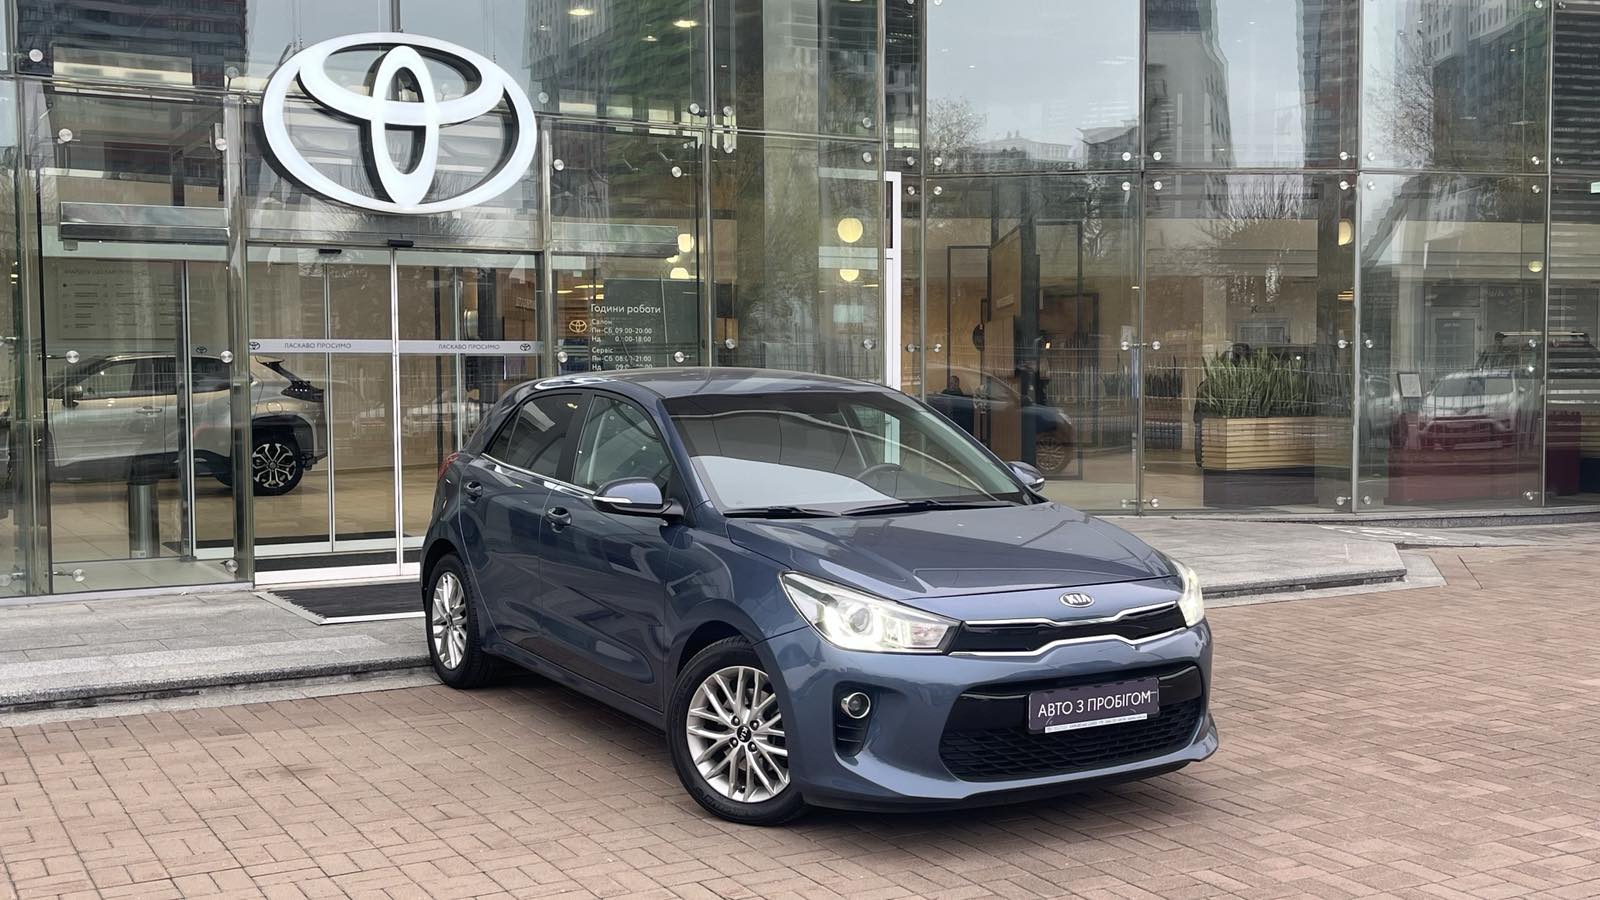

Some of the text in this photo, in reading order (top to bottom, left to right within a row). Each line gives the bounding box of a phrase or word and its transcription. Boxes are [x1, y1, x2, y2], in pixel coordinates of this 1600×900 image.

[590, 303, 661, 315] Години роботи
[1063, 594, 1092, 604] KIA
[1037, 701, 1073, 718] АВТО
[1087, 690, 1151, 712] ПРОБІГОМ
